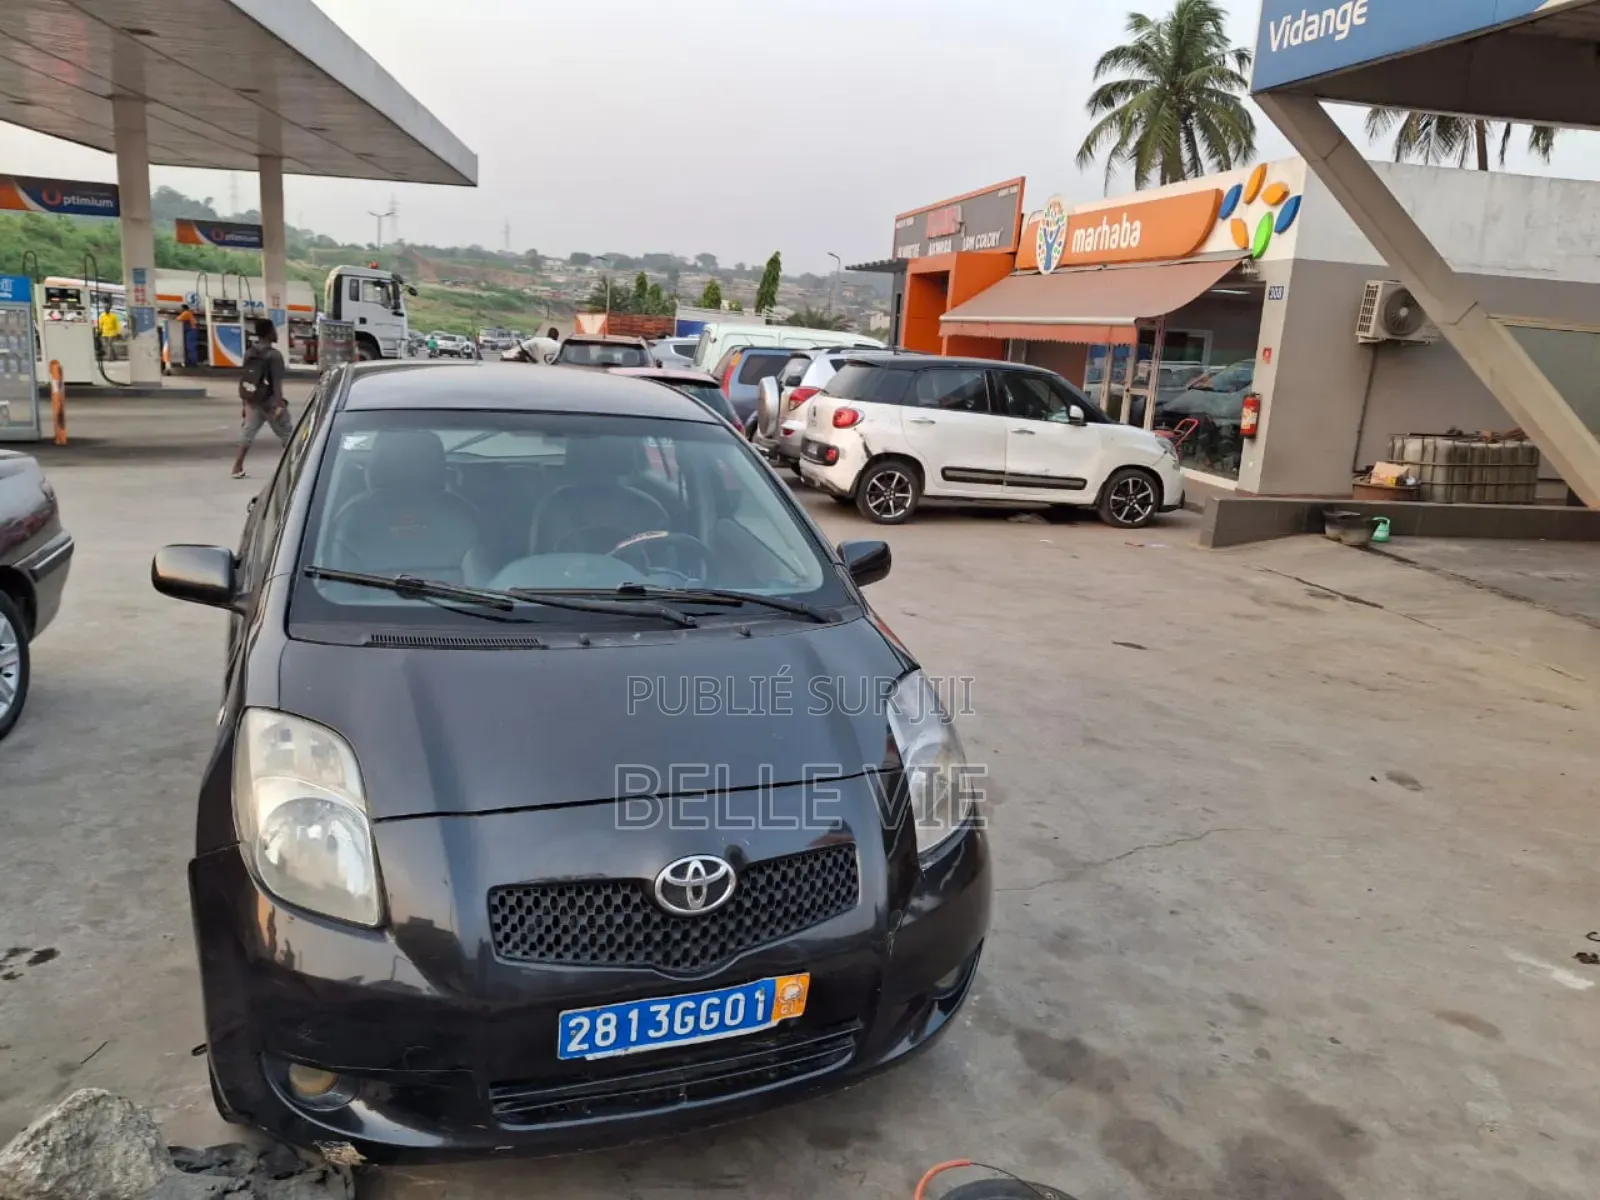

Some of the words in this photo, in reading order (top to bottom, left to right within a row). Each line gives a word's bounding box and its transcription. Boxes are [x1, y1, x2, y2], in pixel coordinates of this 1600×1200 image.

[1269, 0, 1369, 52] Vidange
[1071, 211, 1141, 253] marhaba
[566, 987, 765, 1052] 2813GG01
